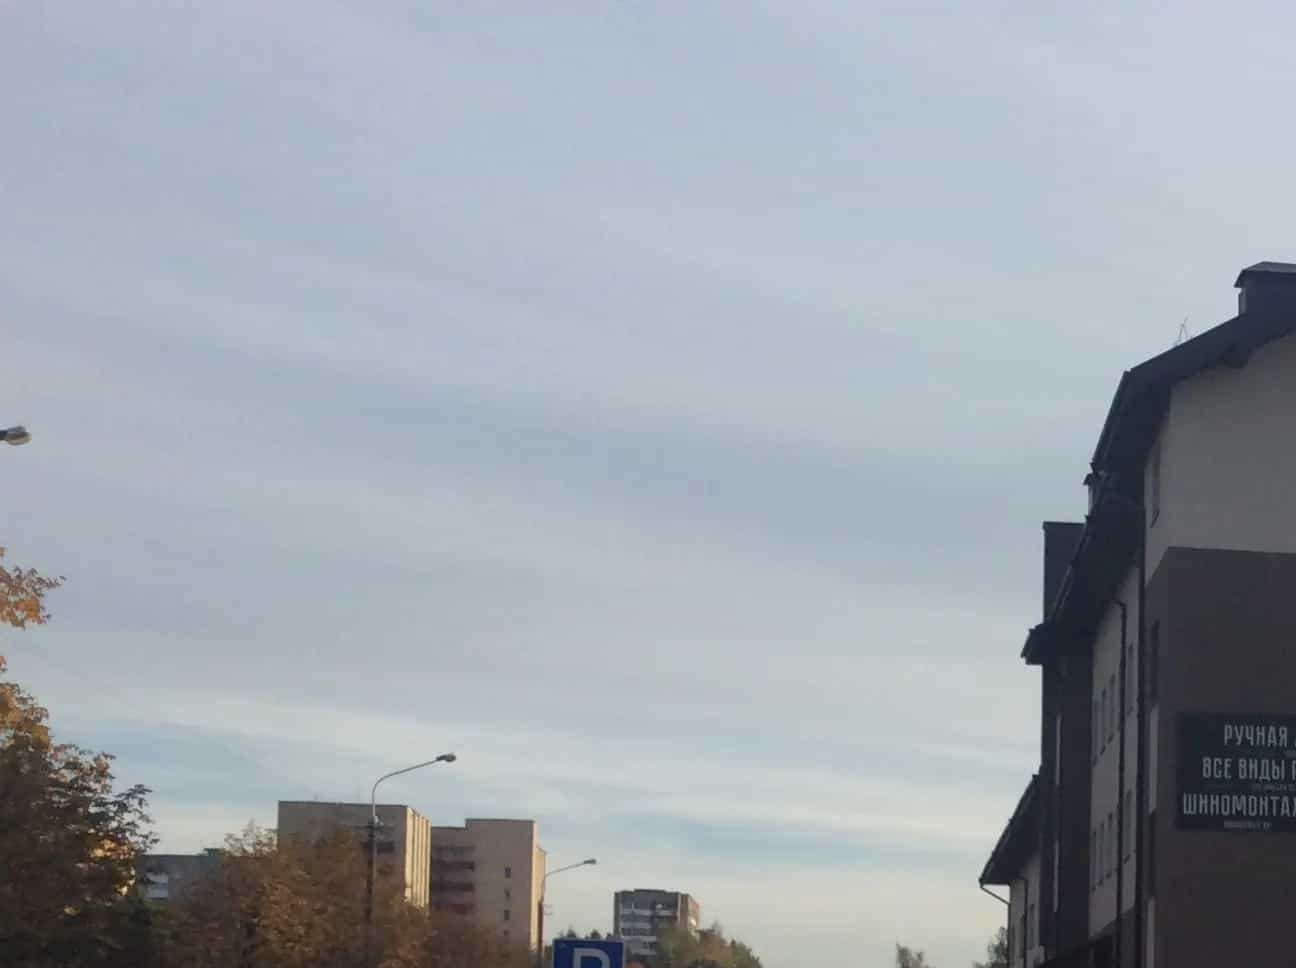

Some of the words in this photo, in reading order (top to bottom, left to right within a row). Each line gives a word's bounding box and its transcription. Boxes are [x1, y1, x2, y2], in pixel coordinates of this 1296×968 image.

[1223, 724, 1288, 748] РУЧНАЯ
[1202, 757, 1232, 779] ВСЕ
[1238, 758, 1285, 782] ВИДЫ
